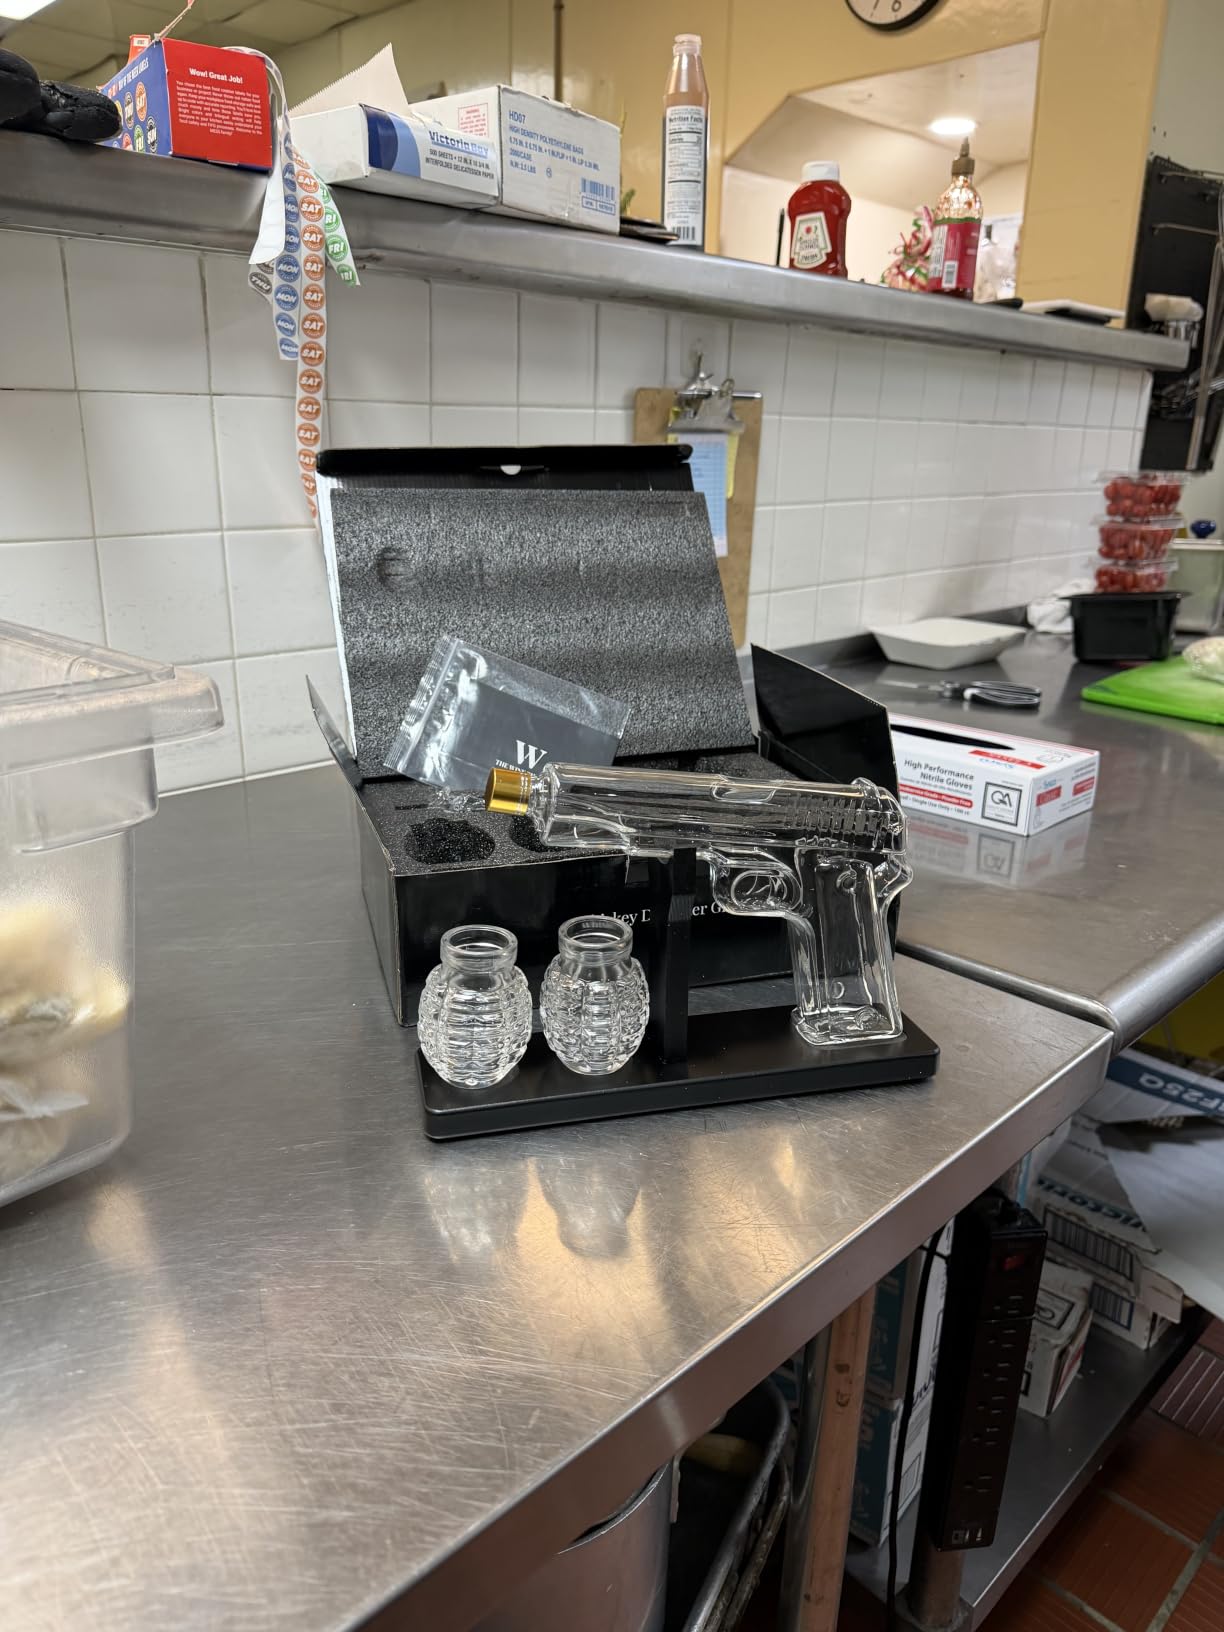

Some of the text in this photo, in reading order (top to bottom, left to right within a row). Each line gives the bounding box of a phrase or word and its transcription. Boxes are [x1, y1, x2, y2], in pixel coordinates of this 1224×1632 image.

[189, 68, 243, 84] Wow! Great Job!
[425, 157, 494, 180] INTERFOLDED DELICATESSEN PAPER
[298, 176, 316, 186] SAT
[301, 202, 322, 214] SAT
[303, 232, 323, 242] SAT
[328, 242, 344, 254] FRI
[278, 264, 299, 274] MON
[304, 262, 323, 272] SAT
[252, 276, 271, 290] THU
[276, 292, 297, 302] MON
[304, 292, 323, 302] SAT
[277, 320, 295, 330] MON
[303, 320, 324, 330] SAT
[302, 348, 322, 358] SAT
[300, 376, 321, 386] SAT
[298, 404, 320, 413] SAT
[298, 429, 319, 440] SAT
[516, 740, 548, 769] W
[495, 758, 508, 770] THE
[904, 760, 922, 770] High
[924, 763, 974, 780] Performance
[920, 772, 944, 783] Nitrile
[946, 778, 973, 790] Gloves
